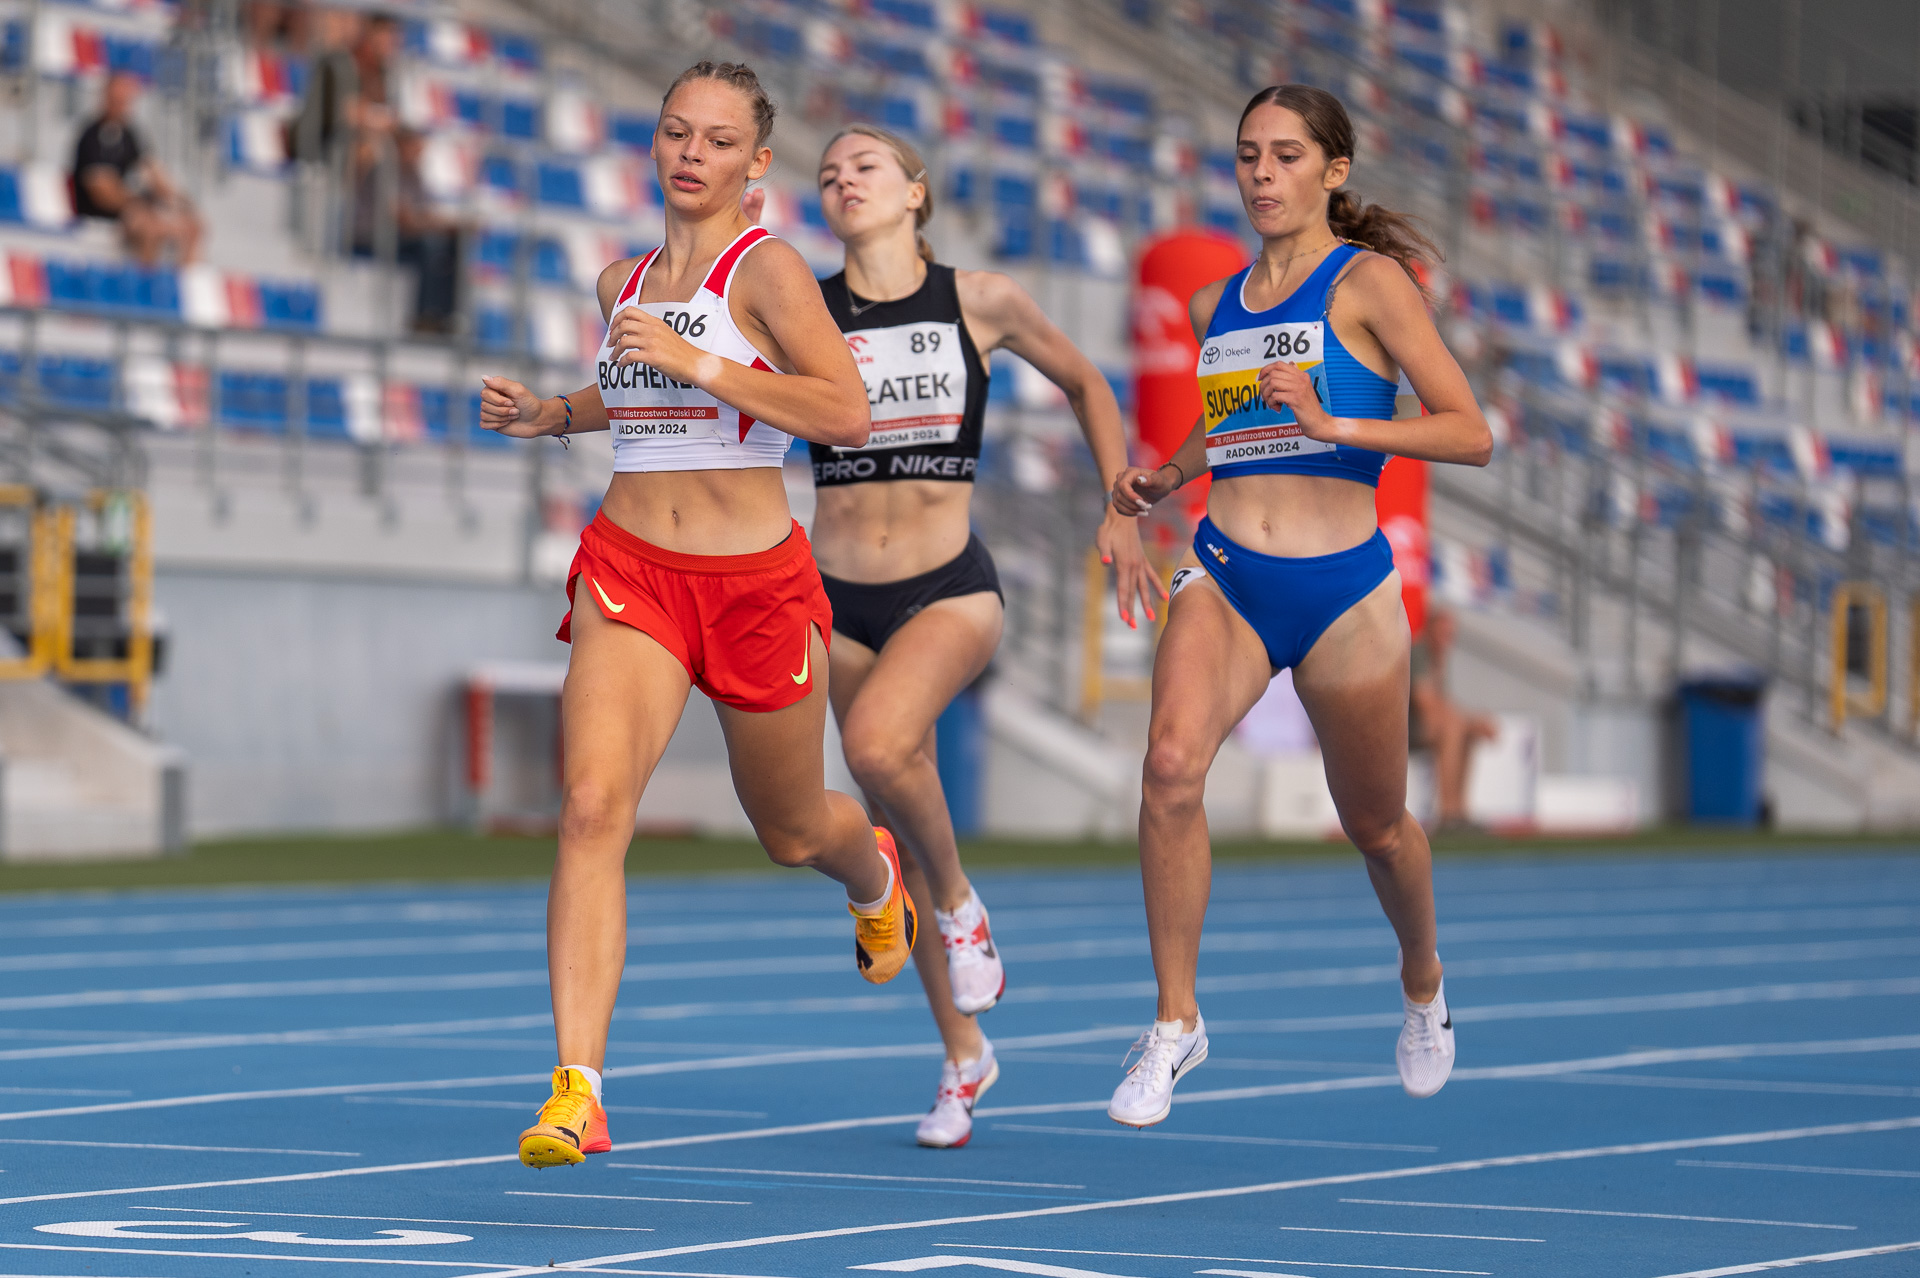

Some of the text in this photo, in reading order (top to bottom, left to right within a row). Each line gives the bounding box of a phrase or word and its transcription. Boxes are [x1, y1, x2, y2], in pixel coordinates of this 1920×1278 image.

[662, 311, 708, 338] 506
[910, 331, 941, 353] 89
[1263, 330, 1311, 360] 286
[1225, 346, 1251, 358] Okęcie
[622, 409, 668, 418] Mistrzostwa
[669, 409, 690, 418] Polski
[692, 409, 706, 418] U20
[658, 424, 687, 435] 2024
[867, 429, 941, 444] ADOM 2024
[1236, 431, 1277, 442] Mistrzostwa
[1226, 441, 1300, 459] RADOM 2024
